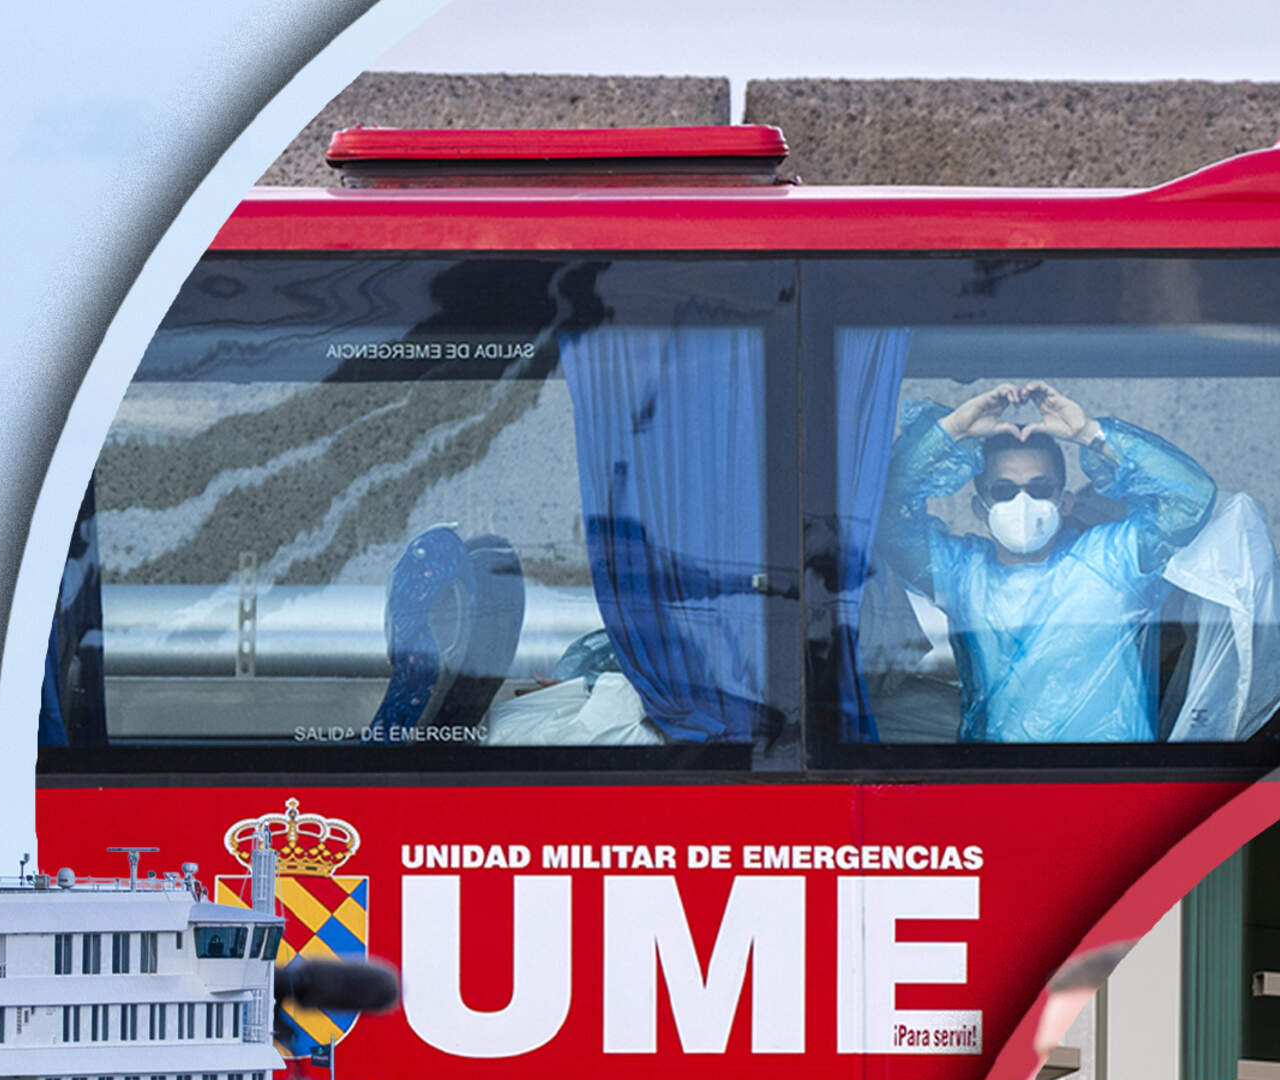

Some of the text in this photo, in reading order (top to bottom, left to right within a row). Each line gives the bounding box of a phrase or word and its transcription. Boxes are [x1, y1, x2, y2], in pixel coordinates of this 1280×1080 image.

[294, 726, 355, 741] SALIDA
[361, 726, 384, 741] DE
[401, 845, 984, 870] UNIDAD MILITAR DE EMERGENCIAS
[402, 875, 982, 1058] UME
[893, 1024, 977, 1047] ¡Para servir!
